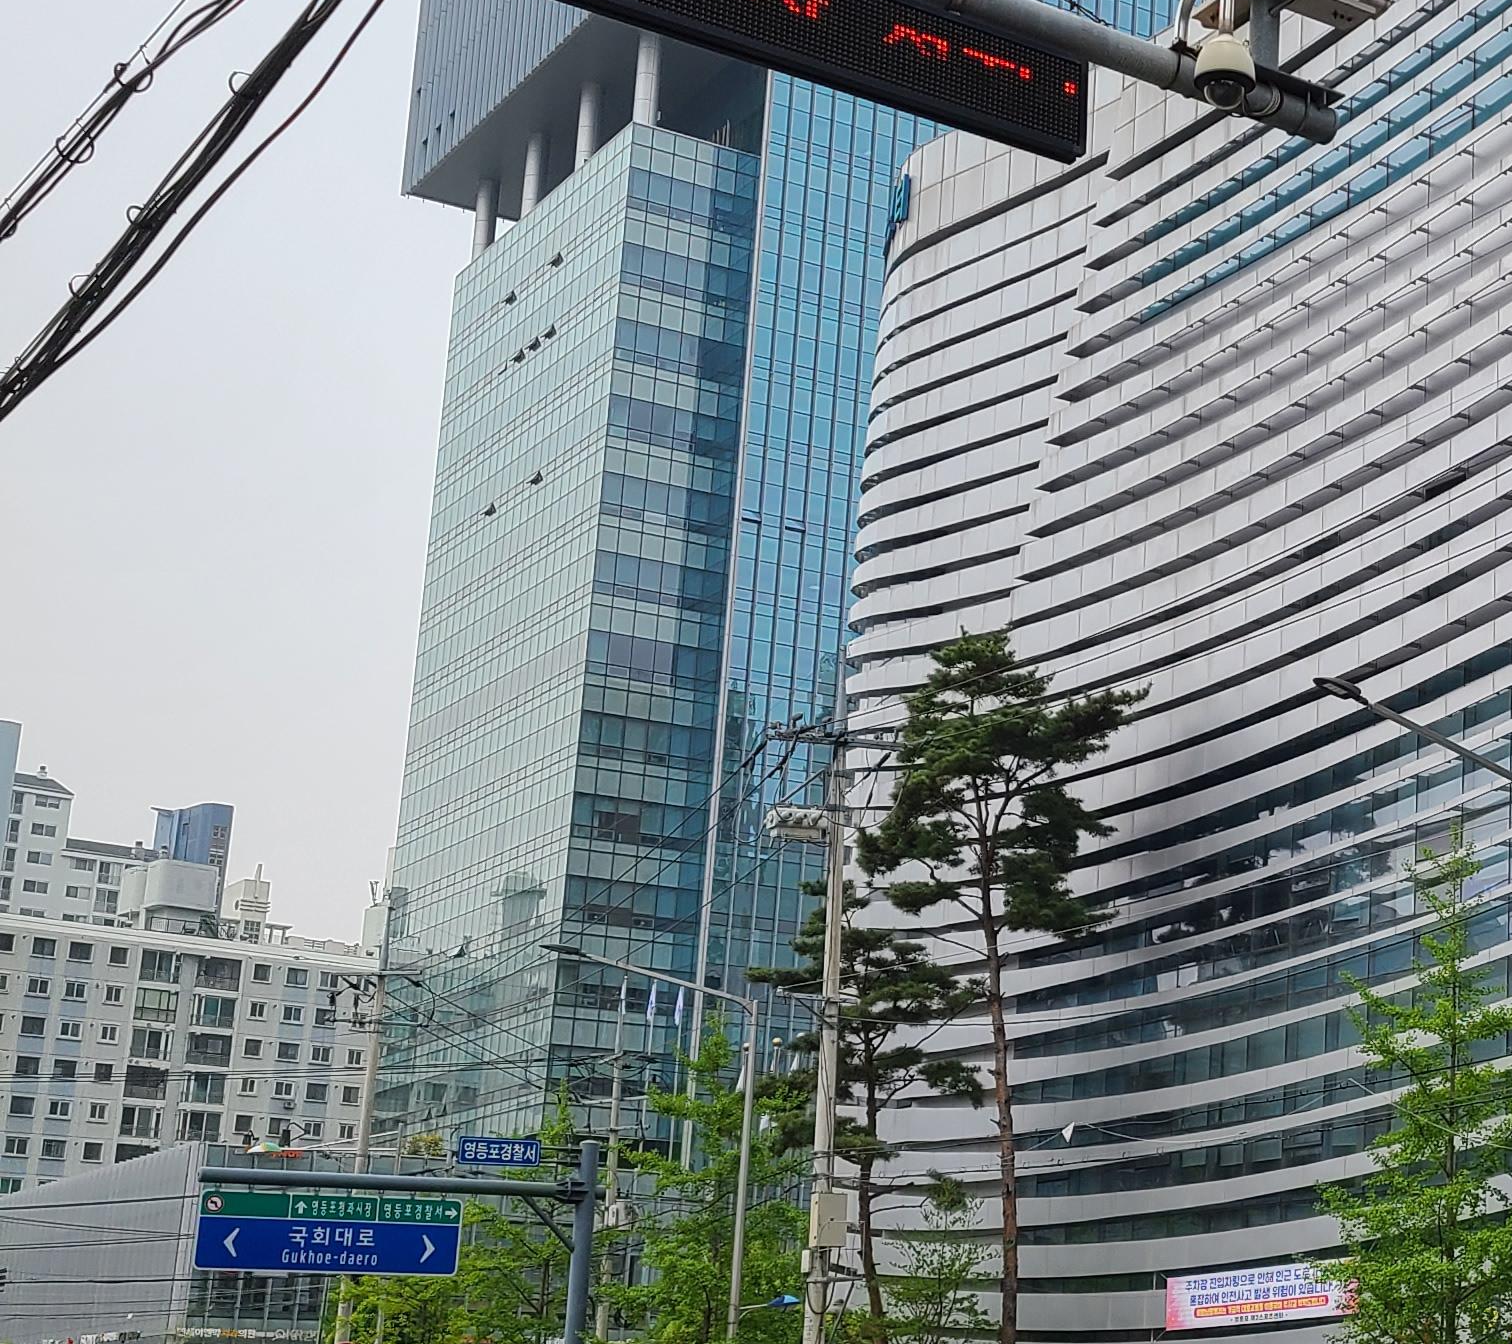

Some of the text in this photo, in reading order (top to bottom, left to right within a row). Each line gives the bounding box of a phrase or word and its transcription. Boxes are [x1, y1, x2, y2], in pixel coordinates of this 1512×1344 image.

[463, 1142, 537, 1162] 영등포경찰서
[383, 1203, 443, 1220] 영등포경찰서
[288, 1226, 376, 1248] 국회대로
[281, 1248, 378, 1266] Gukhoe-daero
[1275, 1270, 1292, 1282] 인근
